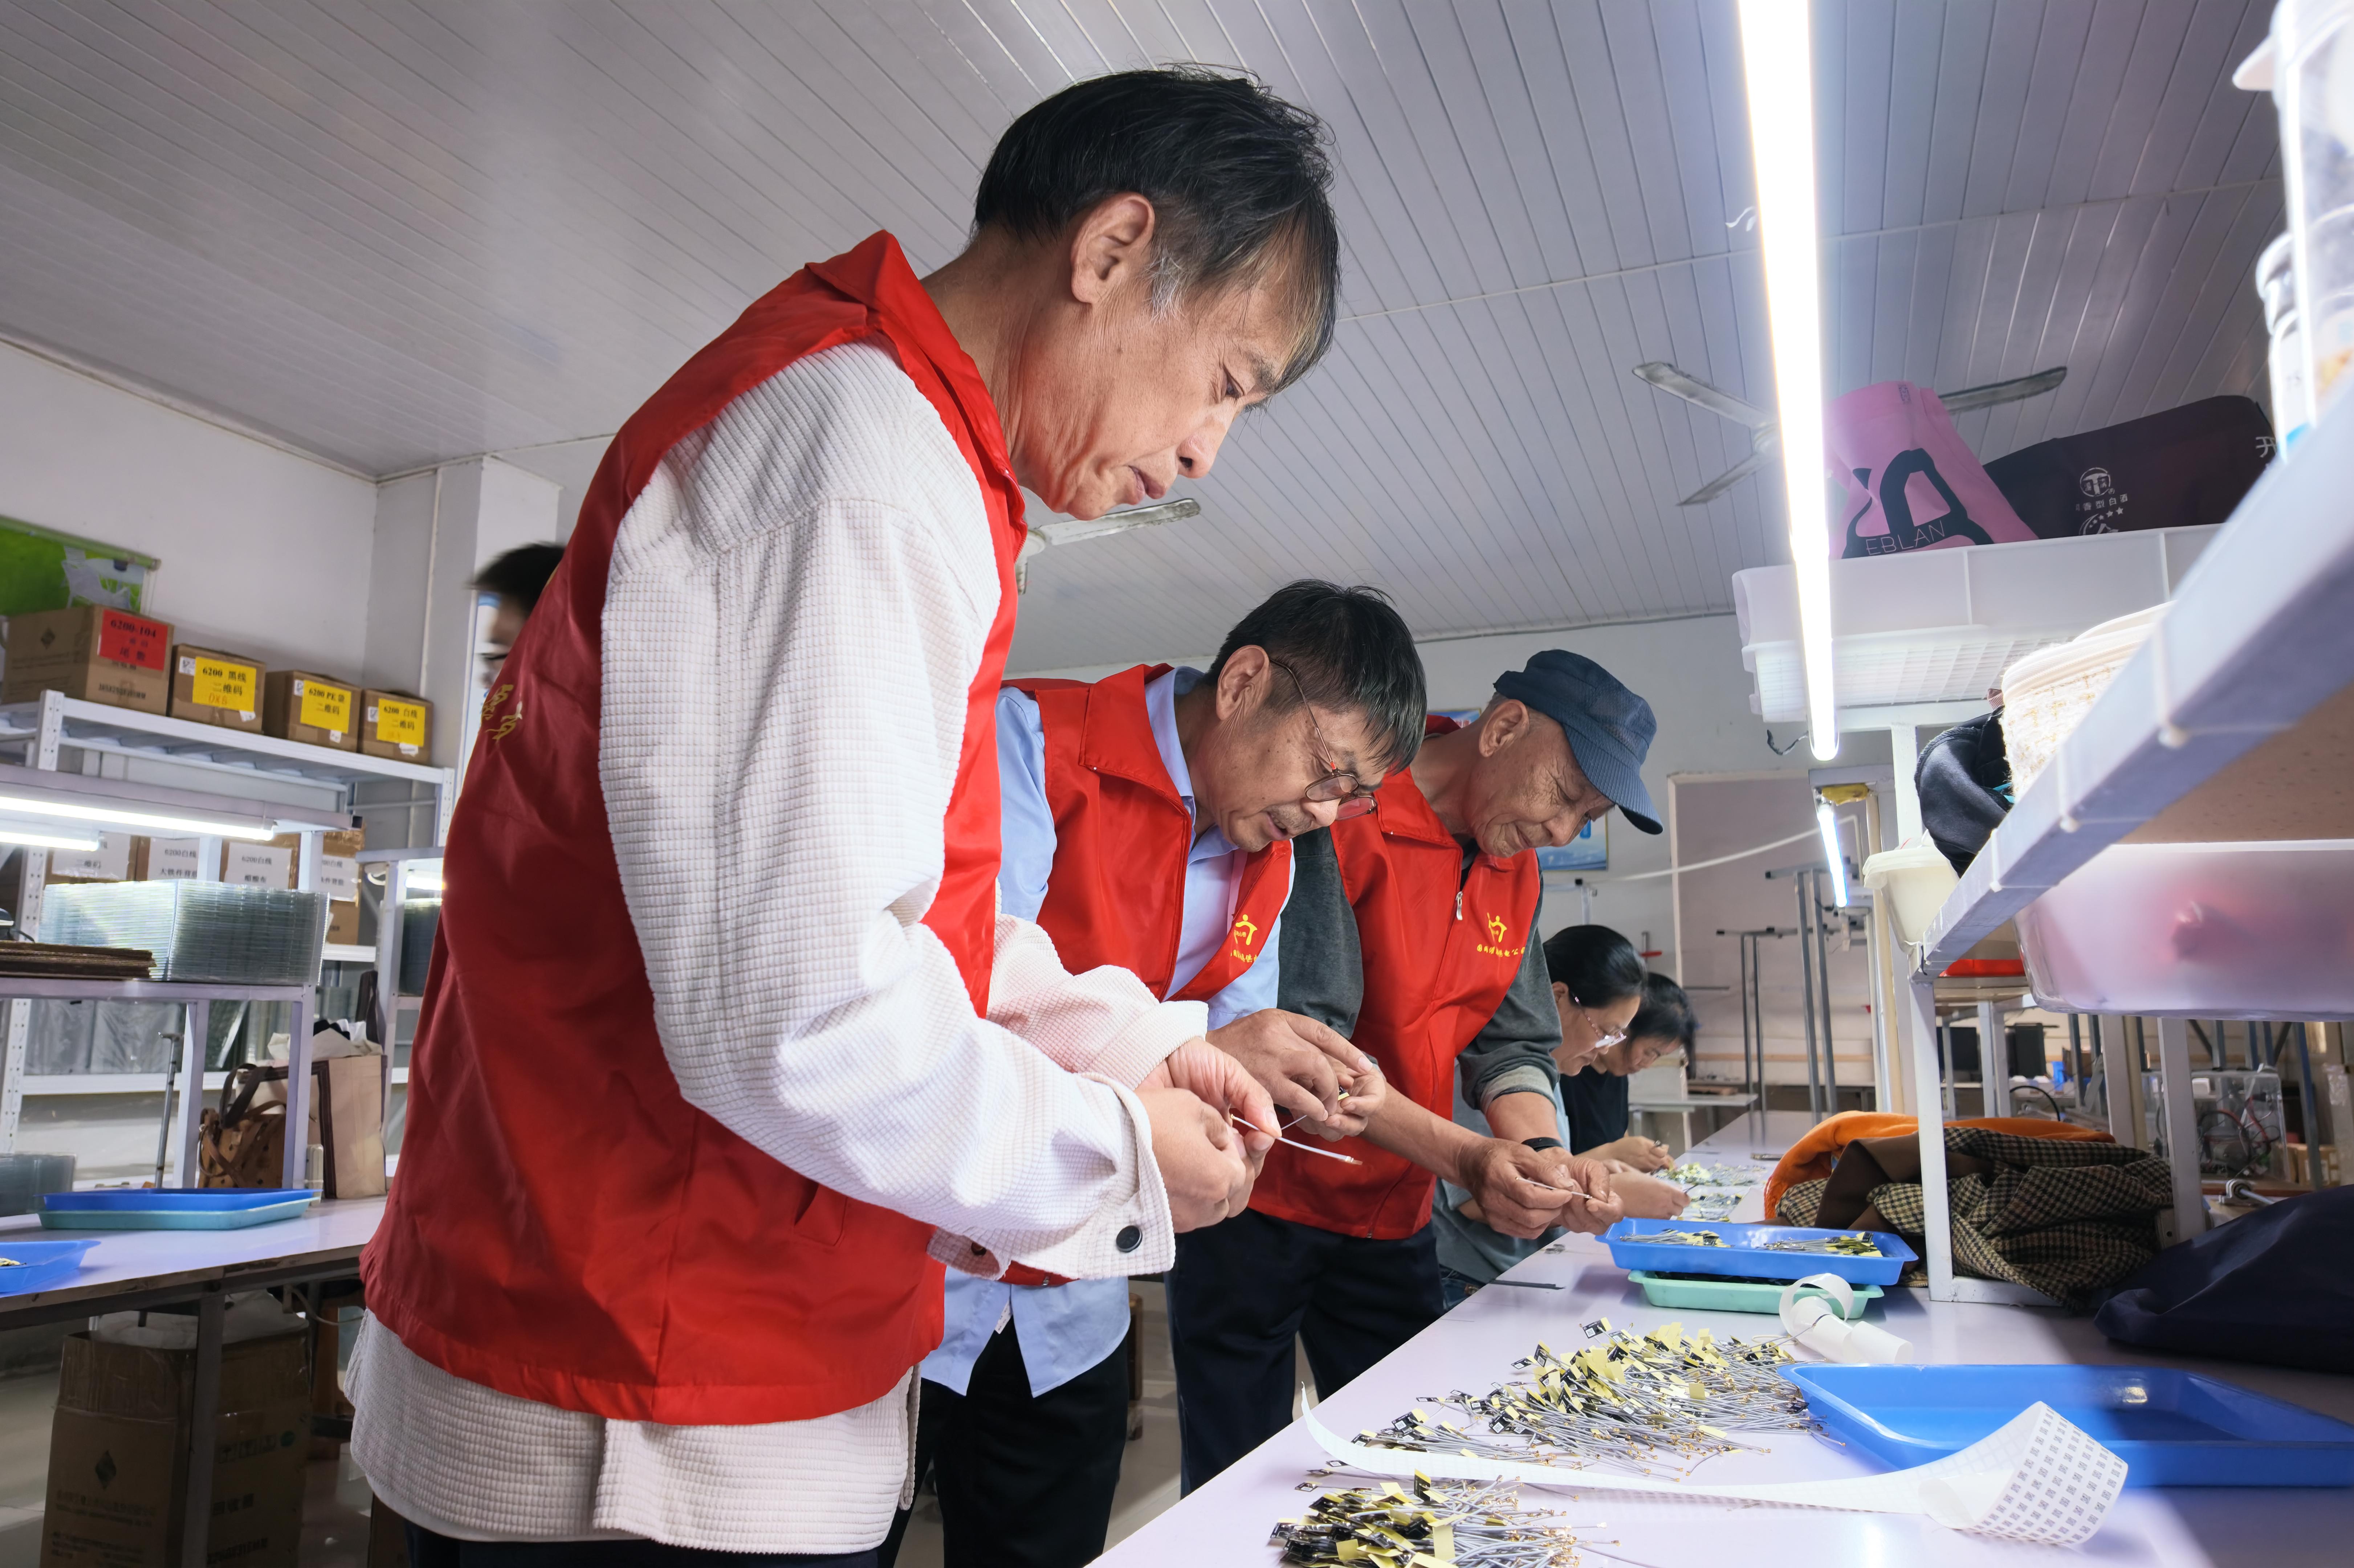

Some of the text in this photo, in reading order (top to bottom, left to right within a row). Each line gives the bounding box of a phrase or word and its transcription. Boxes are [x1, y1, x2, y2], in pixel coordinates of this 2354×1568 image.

[1866, 520, 1945, 556] EBLAN
[110, 619, 156, 638] 6200-104
[203, 667, 223, 678] 6200
[211, 682, 243, 696] 二维码
[309, 688, 325, 698] 6200
[383, 706, 399, 715] 6200
